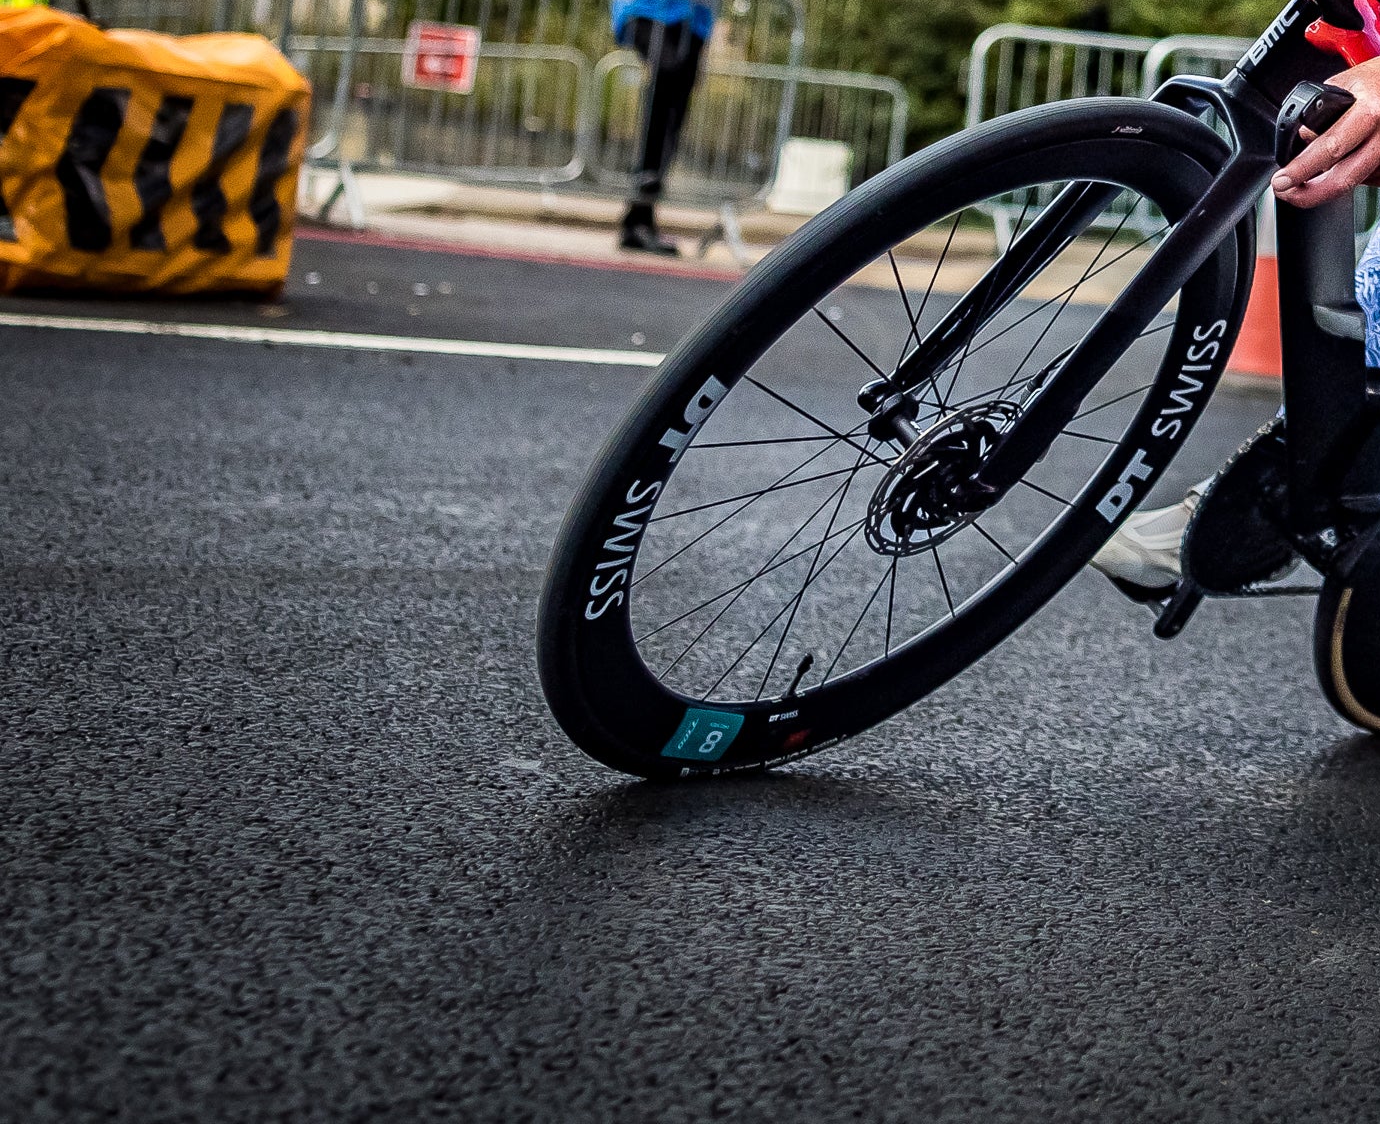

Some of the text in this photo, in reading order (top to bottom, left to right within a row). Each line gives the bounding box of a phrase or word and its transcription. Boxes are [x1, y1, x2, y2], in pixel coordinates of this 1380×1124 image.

[1249, 9, 1300, 67] BMC
[1095, 319, 1228, 524] DT SWISS
[584, 374, 729, 621] DT SWISS
[699, 730, 723, 754] 8
